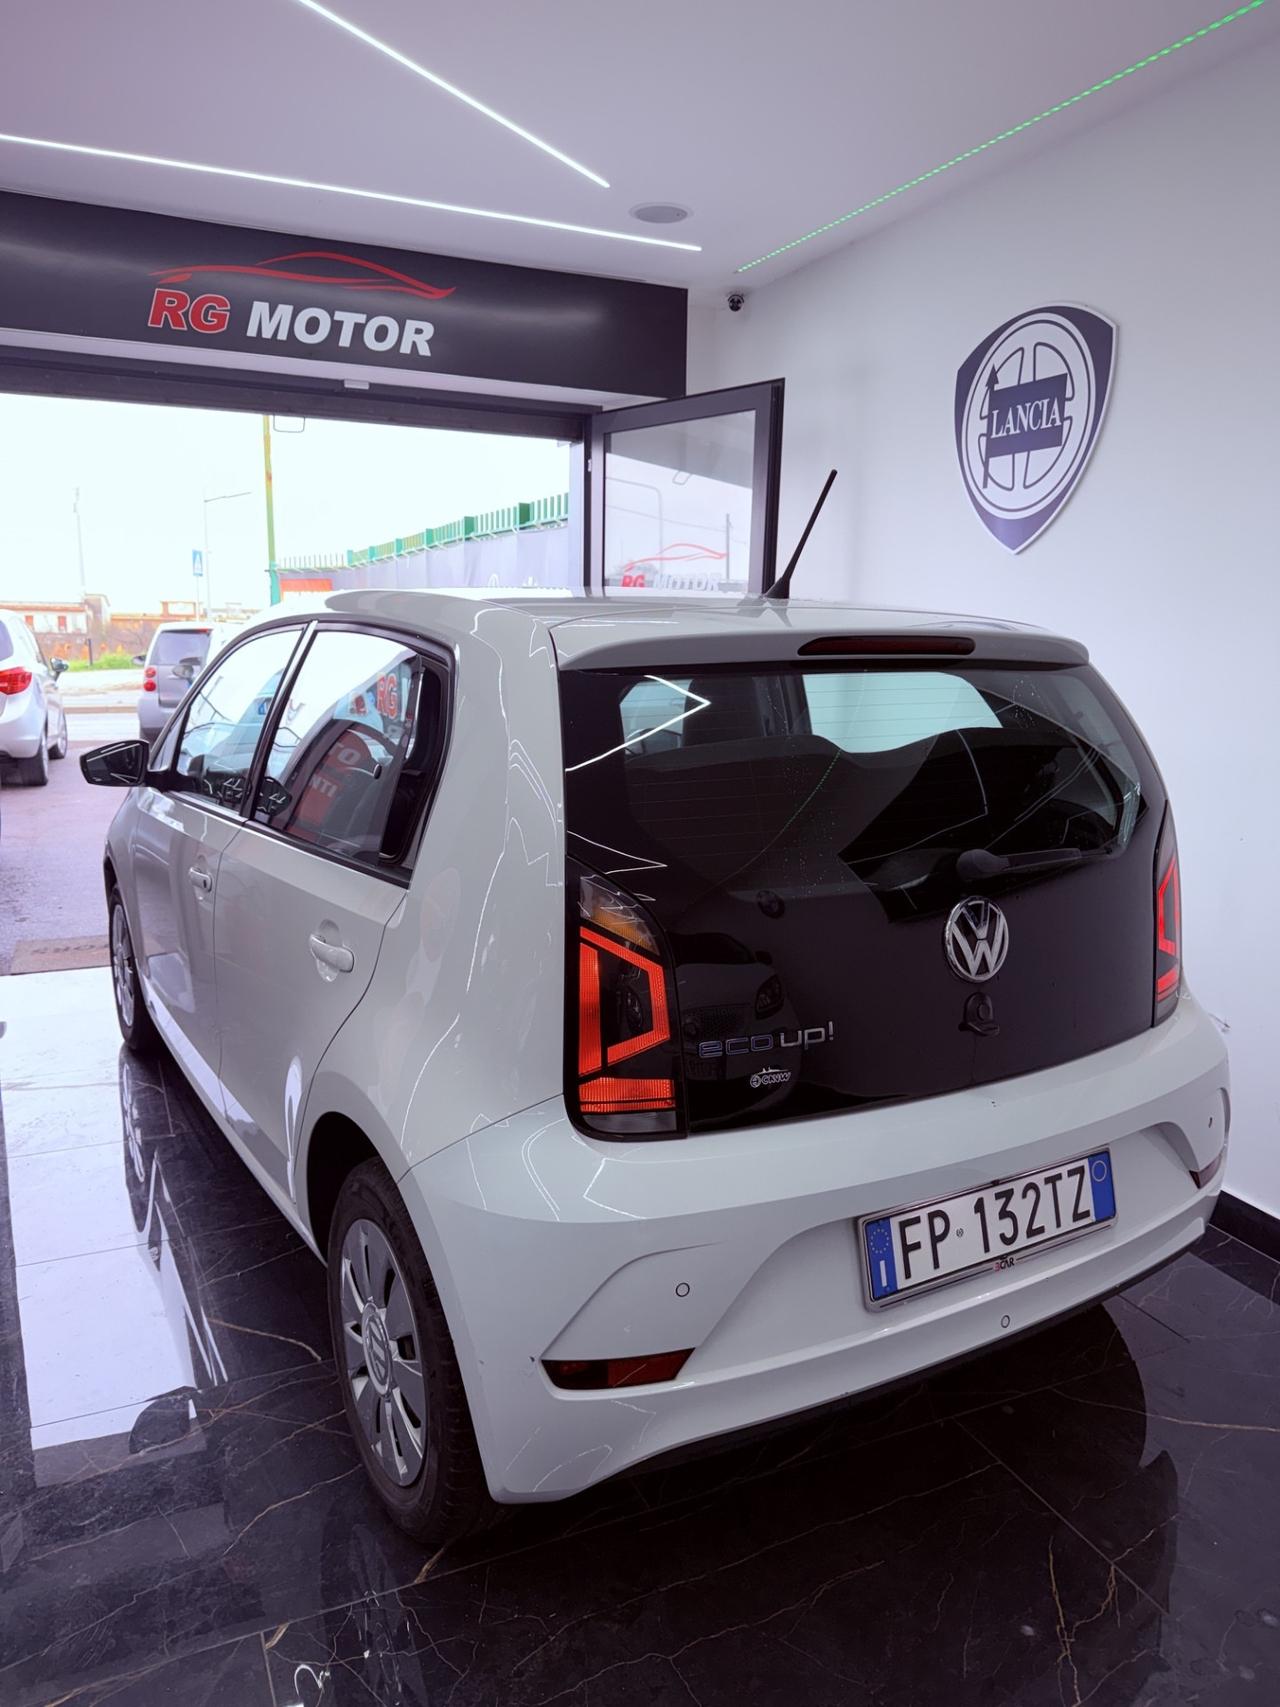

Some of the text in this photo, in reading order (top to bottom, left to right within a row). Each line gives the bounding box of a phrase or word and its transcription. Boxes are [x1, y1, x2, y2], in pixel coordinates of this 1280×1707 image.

[148, 288, 435, 357] RG MOTOR
[990, 397, 1062, 439] LANCIA
[946, 897, 1008, 982] VW
[699, 1021, 834, 1058] eco up!
[898, 1209, 951, 1279] FP
[973, 1165, 1091, 1254] 132TZ
